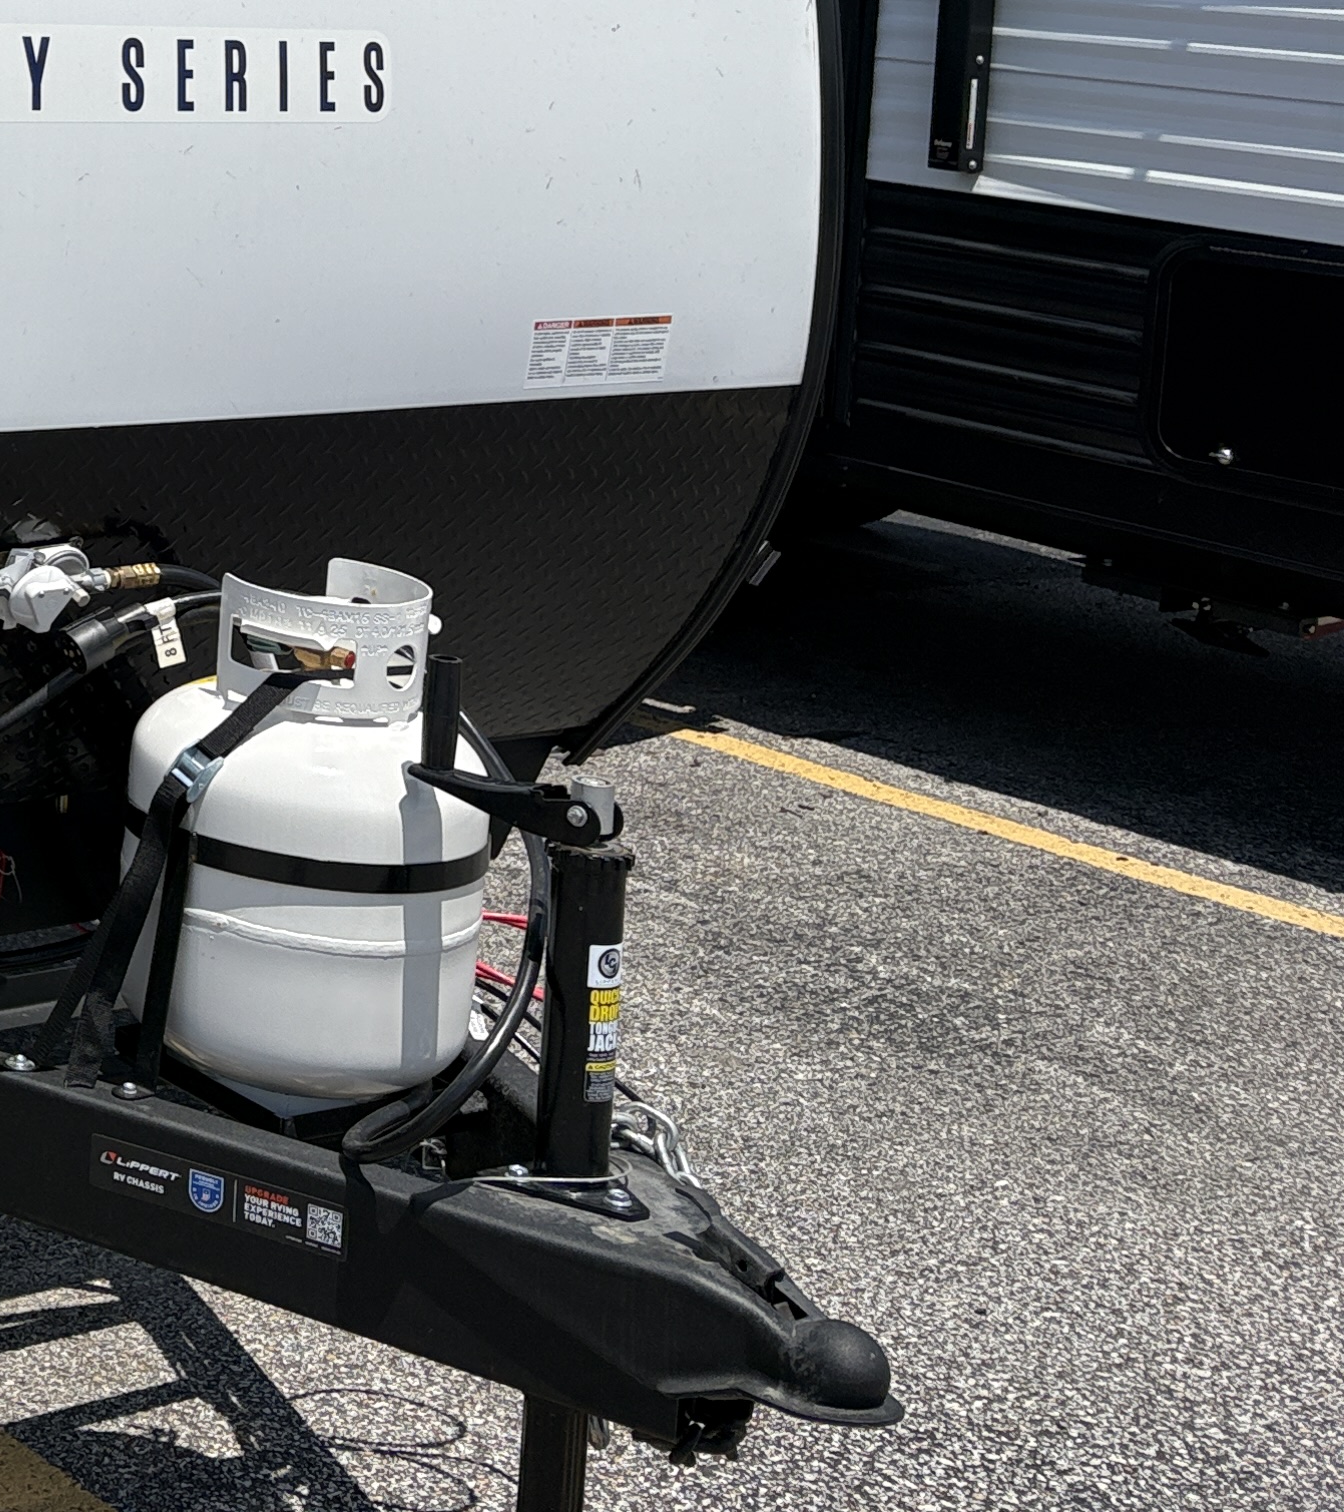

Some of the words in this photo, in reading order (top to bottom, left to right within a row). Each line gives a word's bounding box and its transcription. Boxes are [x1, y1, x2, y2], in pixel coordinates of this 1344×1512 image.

[121, 37, 385, 113] SERIES
[164, 647, 177, 657] 8
[113, 1171, 125, 1183] RV
[126, 1175, 164, 1194] CHASSIS
[244, 1184, 289, 1205] UPGRADE
[244, 1193, 269, 1210] YOUR
[270, 1200, 300, 1217] RVING
[244, 1203, 302, 1228] EXPERIENCE
[244, 1212, 276, 1229] TODAY.
